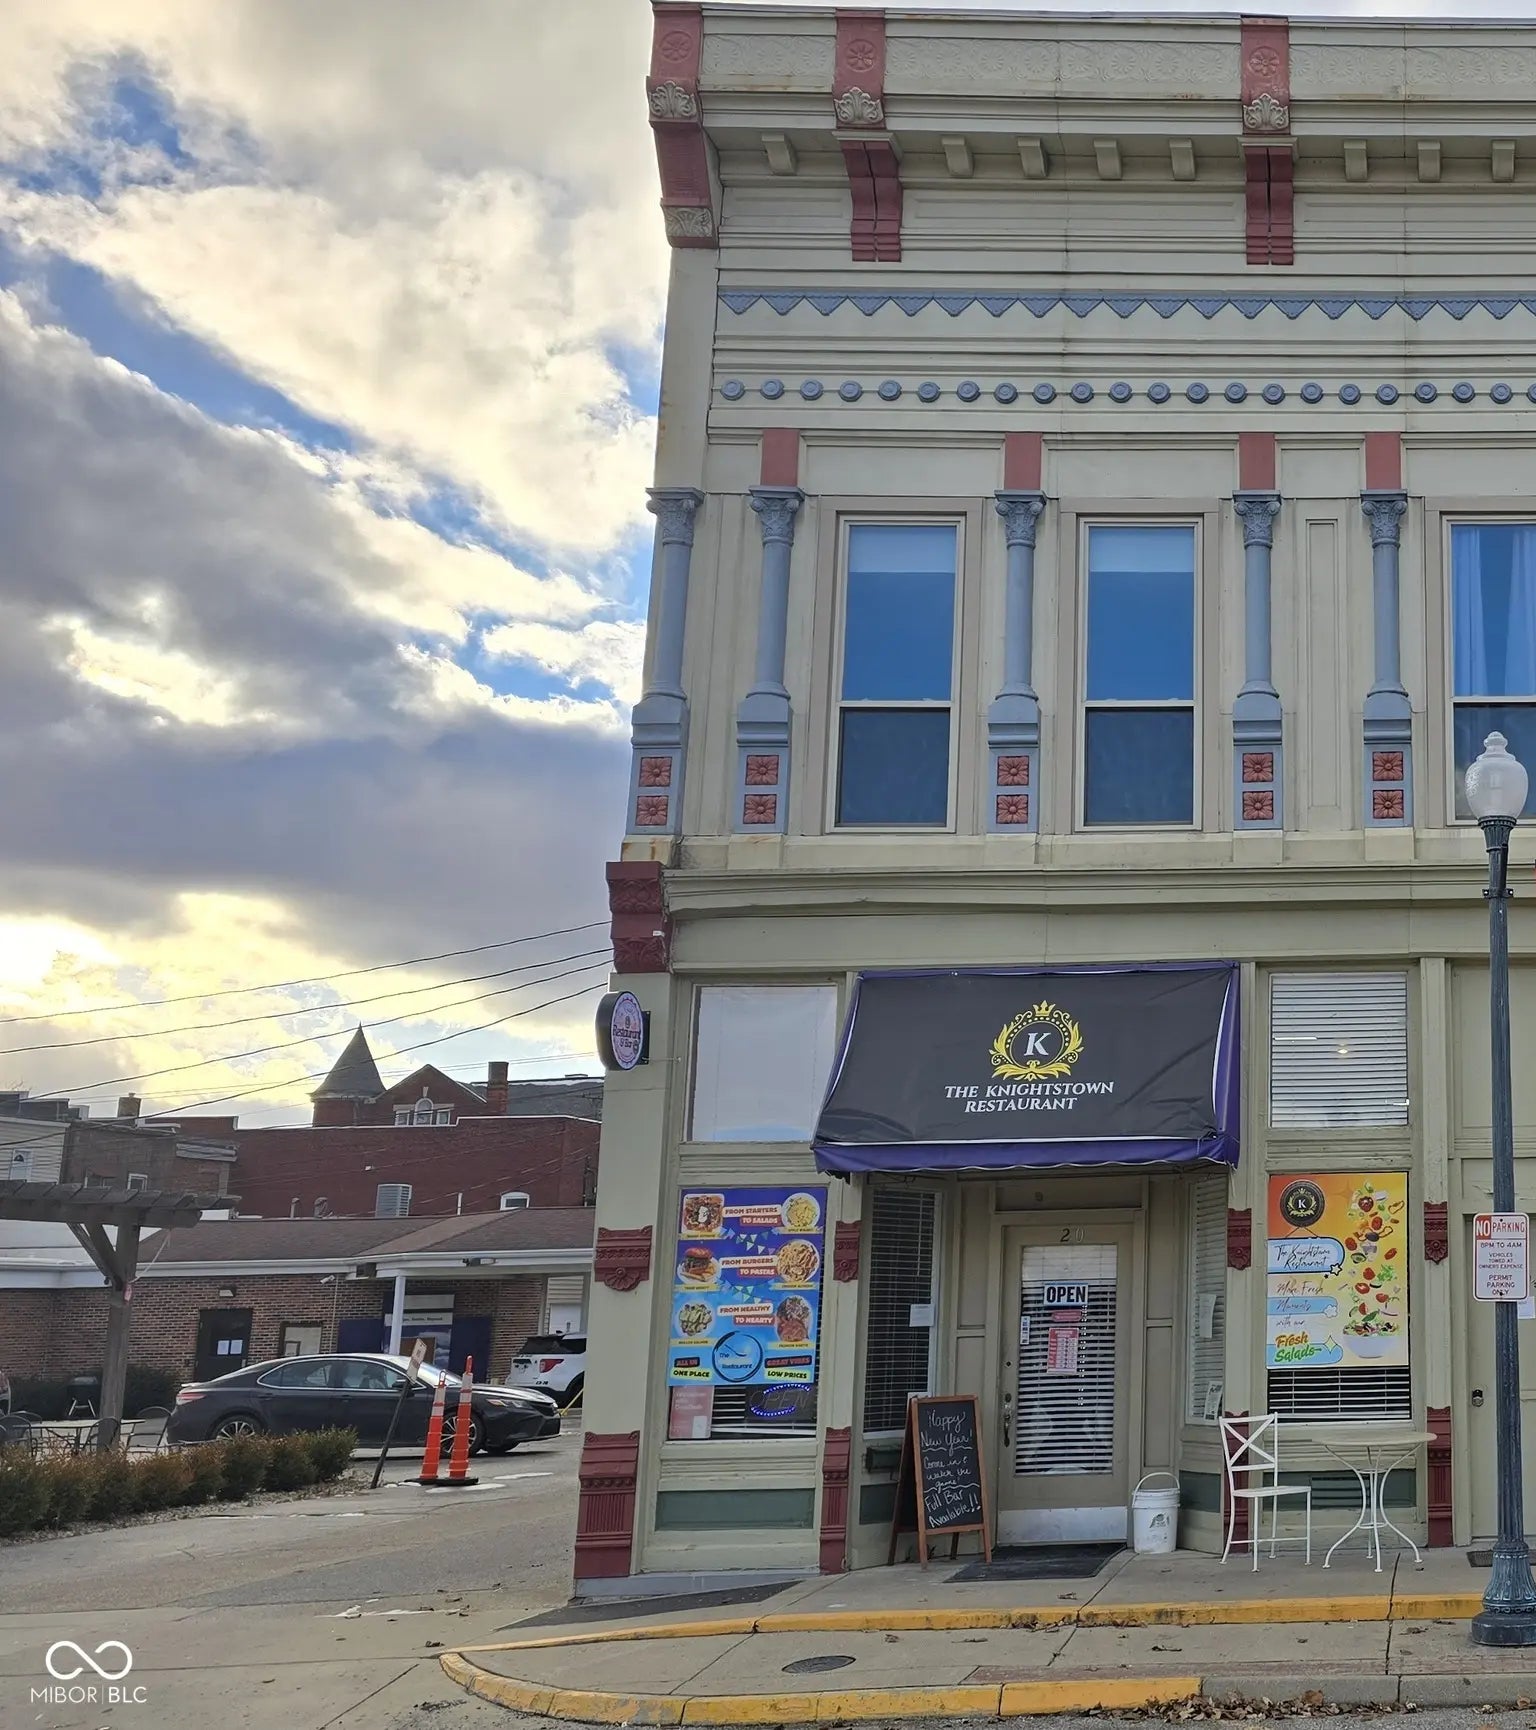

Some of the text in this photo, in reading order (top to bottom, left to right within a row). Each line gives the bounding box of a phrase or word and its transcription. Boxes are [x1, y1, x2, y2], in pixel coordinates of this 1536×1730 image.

[1024, 1032, 1051, 1056] K
[945, 1082, 1114, 1098] THE KNIGHTSTOWN
[965, 1098, 1077, 1113] RESTAURANT
[1298, 1200, 1306, 1209] K
[1476, 1220, 1525, 1237] NO PARKING
[1284, 1255, 1329, 1271] Restaurant
[1046, 1286, 1086, 1303] OPEN
[1301, 1279, 1324, 1294] Fresh
[1276, 1314, 1292, 1326] with
[1275, 1331, 1308, 1348] Fresh
[1274, 1345, 1322, 1363] Salads
[928, 1410, 966, 1432] Happy
[920, 1429, 972, 1456] New Year!
[923, 1456, 945, 1470] Come
[948, 1458, 961, 1466] in
[924, 1490, 963, 1513] Full Bar
